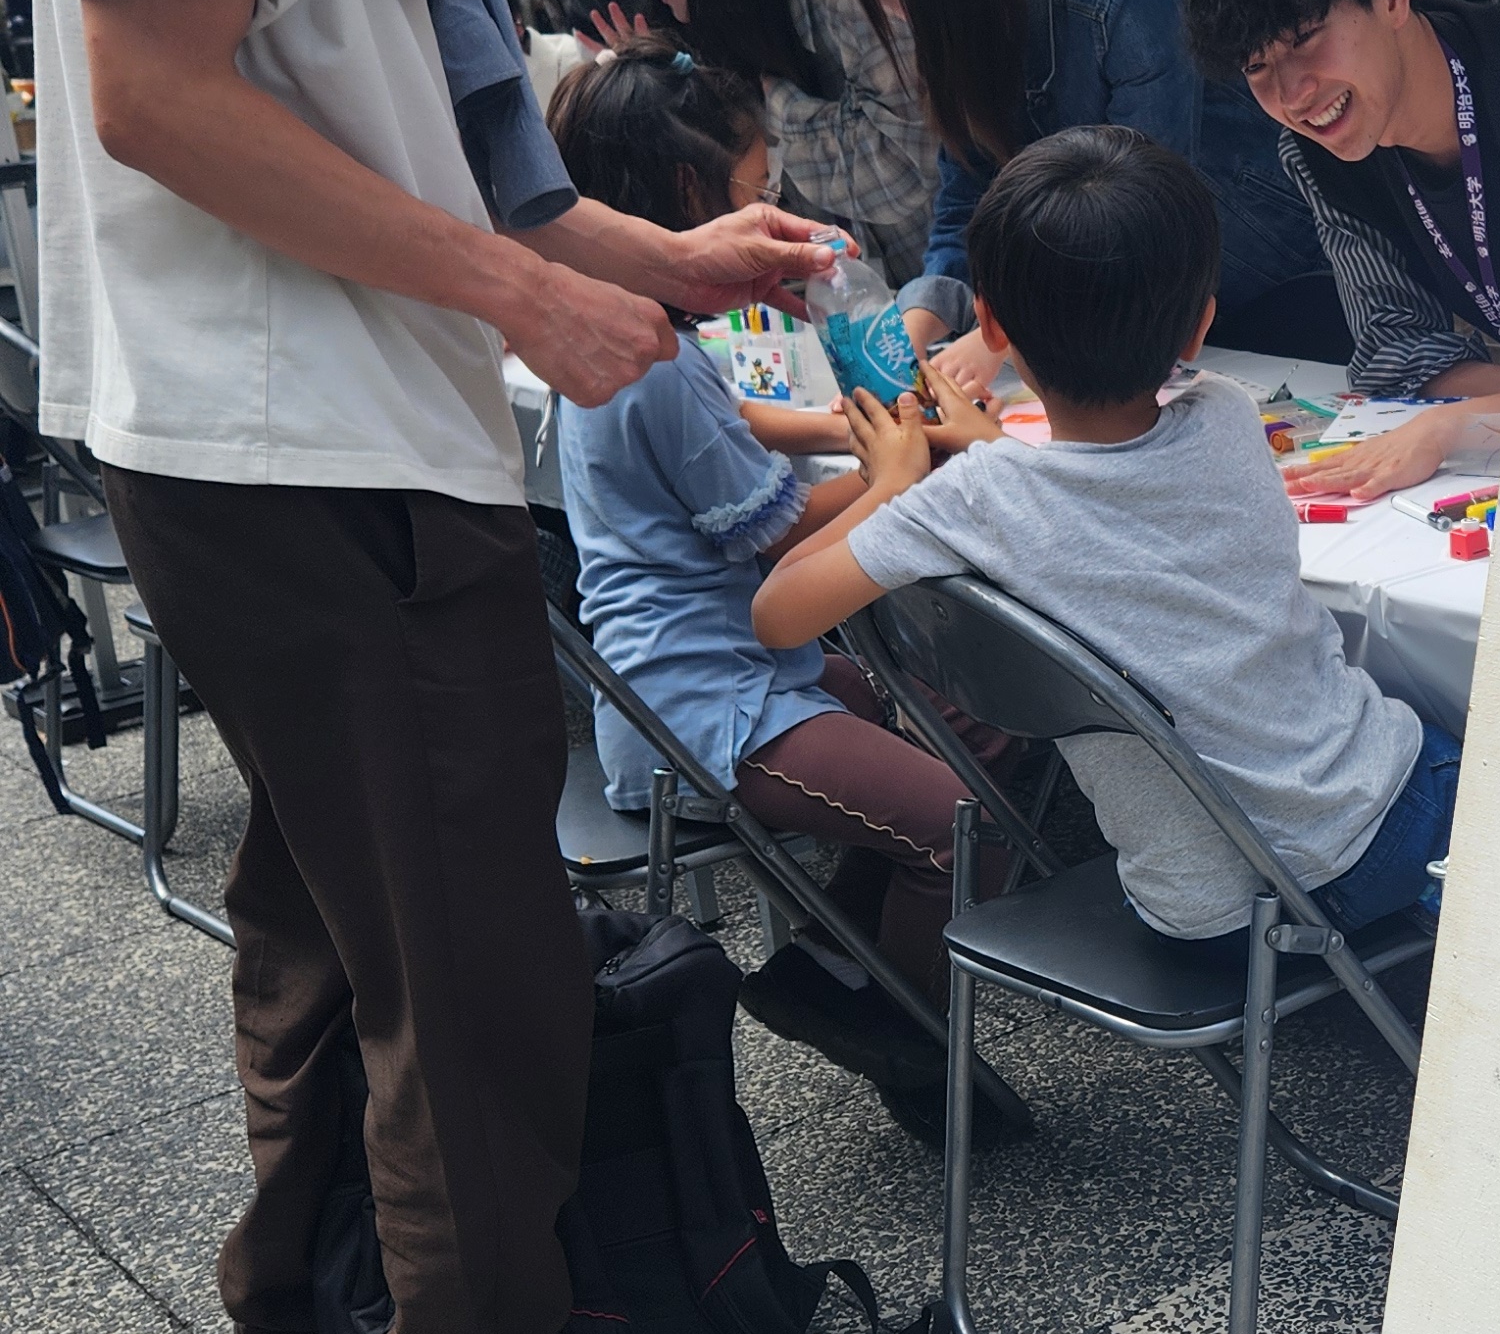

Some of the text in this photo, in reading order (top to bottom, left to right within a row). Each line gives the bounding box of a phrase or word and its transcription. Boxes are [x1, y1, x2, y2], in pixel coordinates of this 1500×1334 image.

[1449, 58, 1475, 129] 明治大学
[1414, 199, 1453, 260] 明治大学
[1466, 176, 1489, 243] 明治大学
[875, 332, 916, 371] 麦
